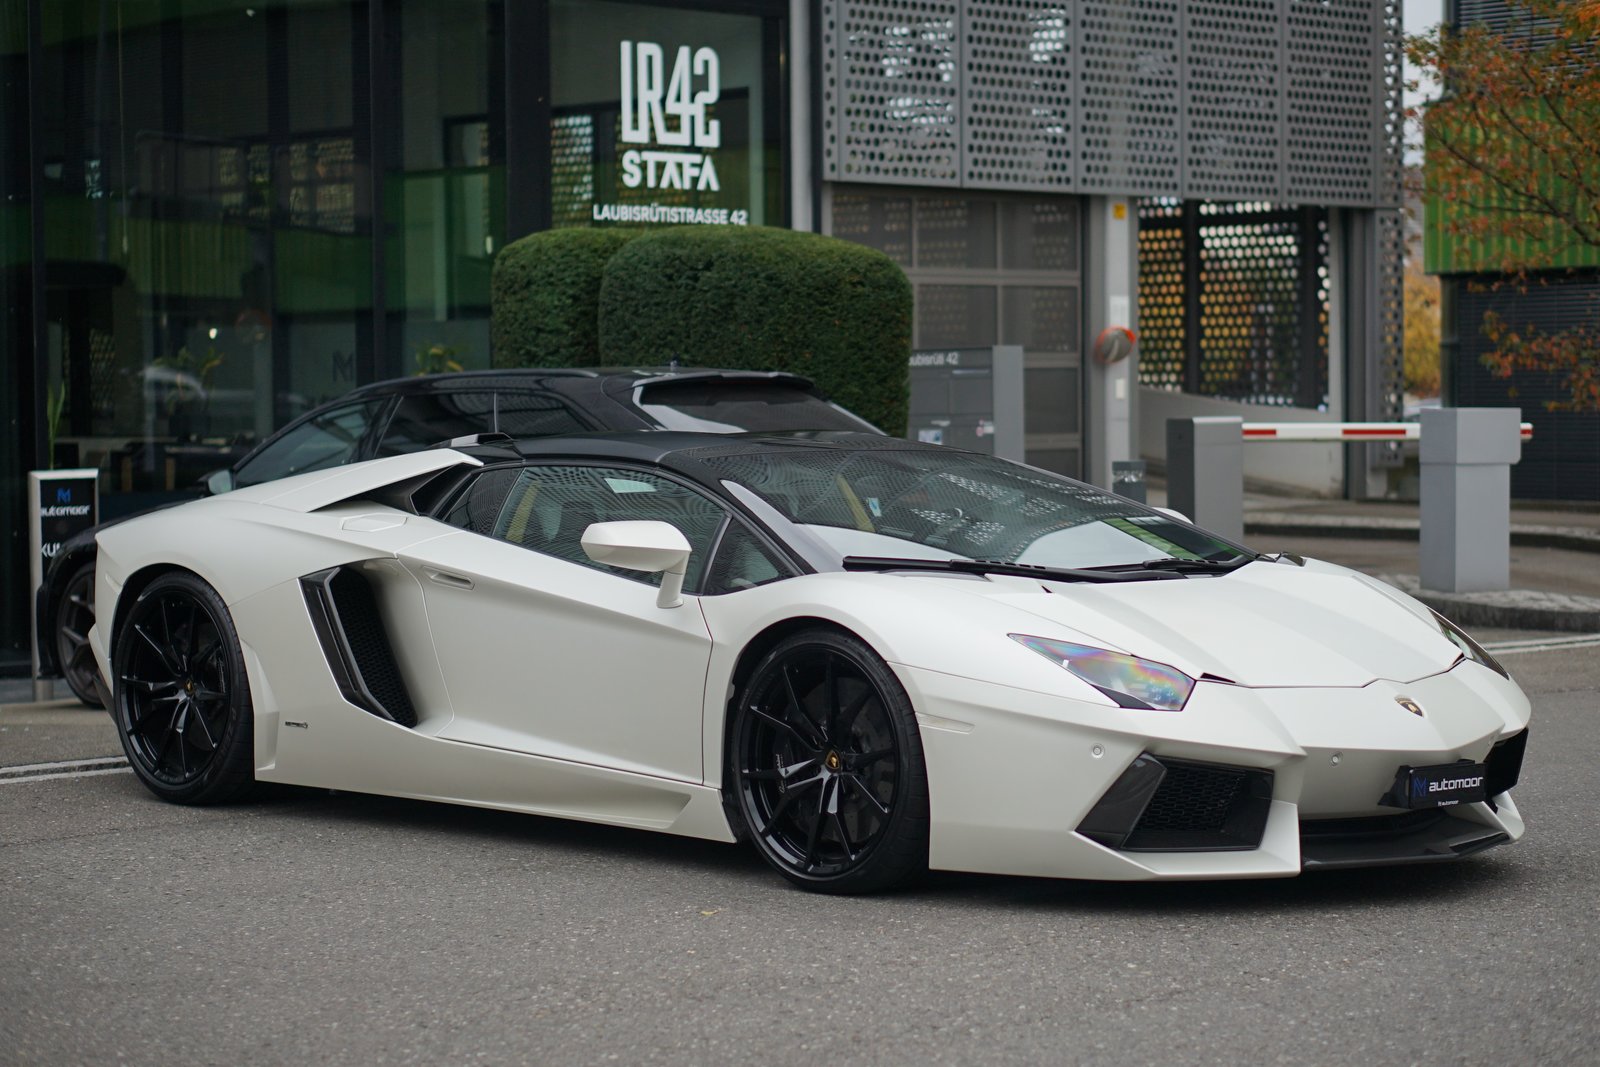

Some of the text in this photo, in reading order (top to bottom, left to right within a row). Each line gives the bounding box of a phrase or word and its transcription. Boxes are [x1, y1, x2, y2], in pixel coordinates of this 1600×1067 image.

[592, 201, 748, 226] LAUBISRÜTISTRASSE 42
[946, 351, 959, 365] 42
[1428, 776, 1484, 792] automoor
